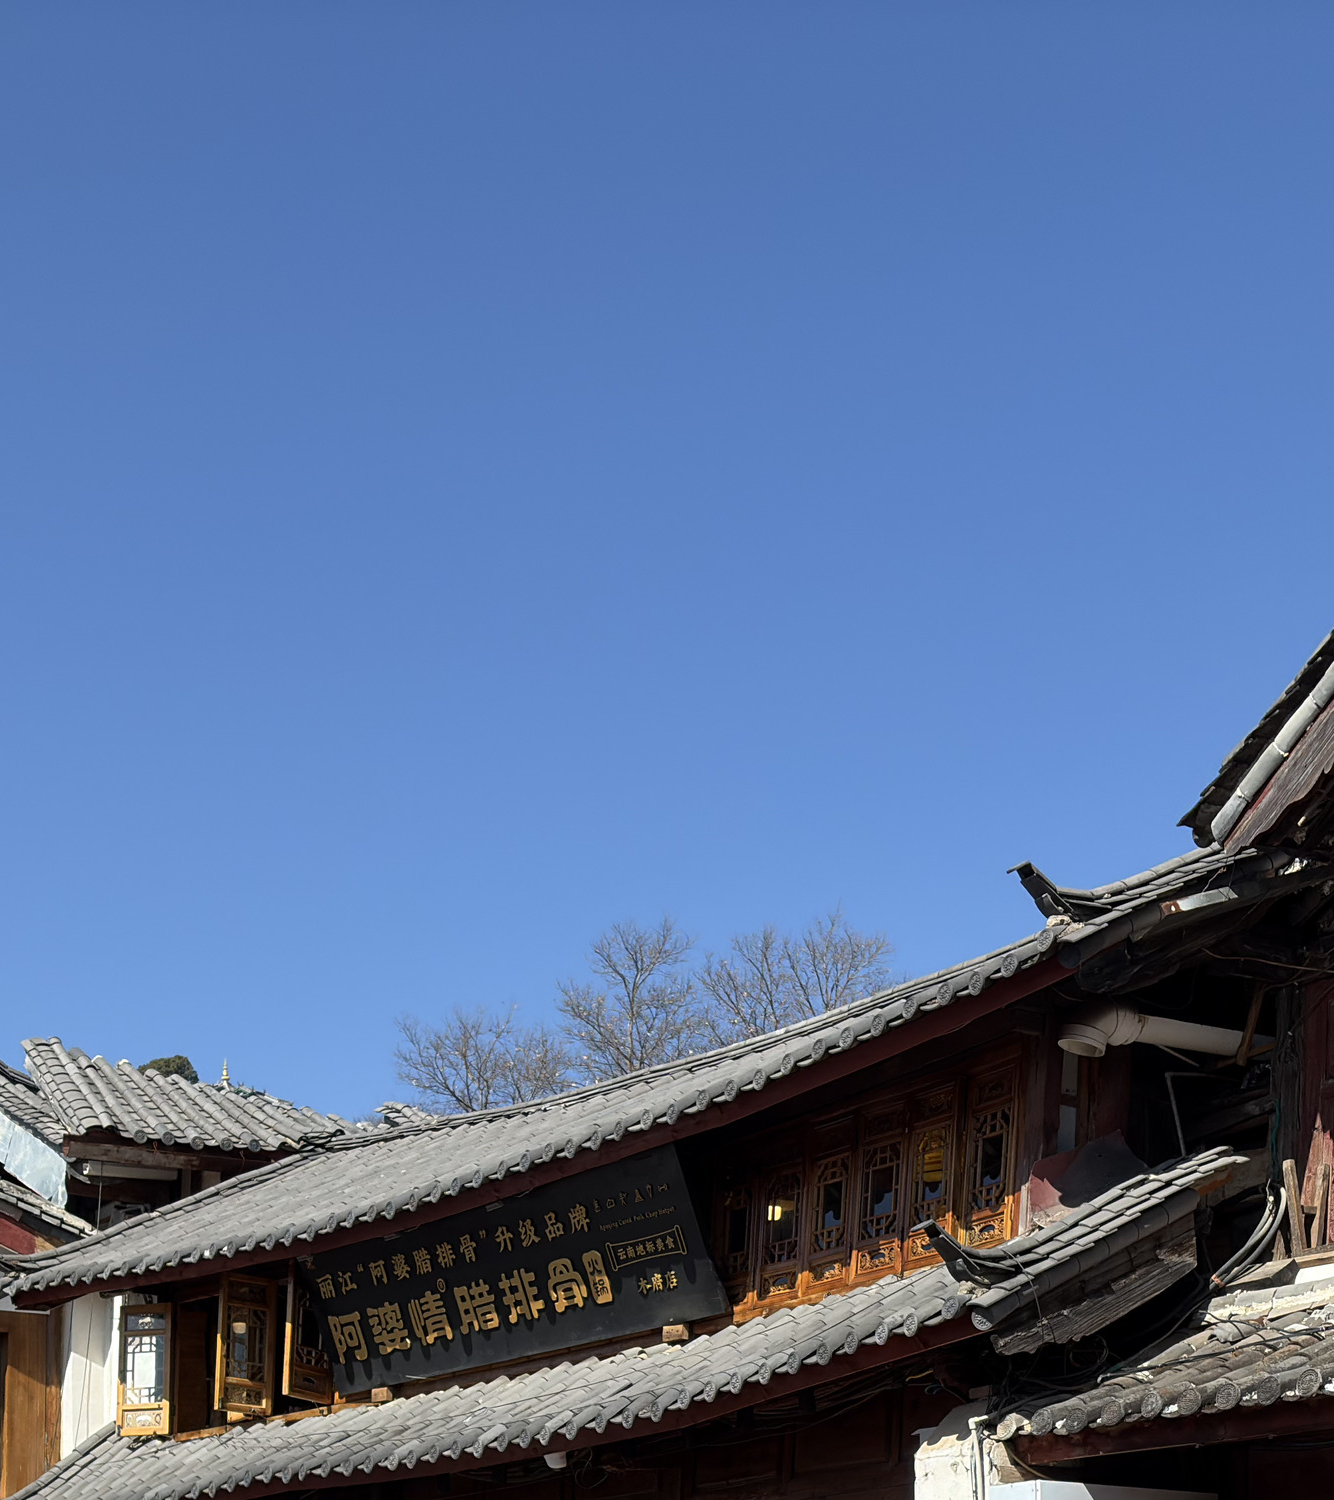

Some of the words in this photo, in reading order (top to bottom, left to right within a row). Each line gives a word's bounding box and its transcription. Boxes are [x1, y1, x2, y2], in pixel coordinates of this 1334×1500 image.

[617, 1235, 675, 1260] 云南地标美食
[586, 1256, 610, 1298] 火锅
[638, 1271, 678, 1294] 木府店
